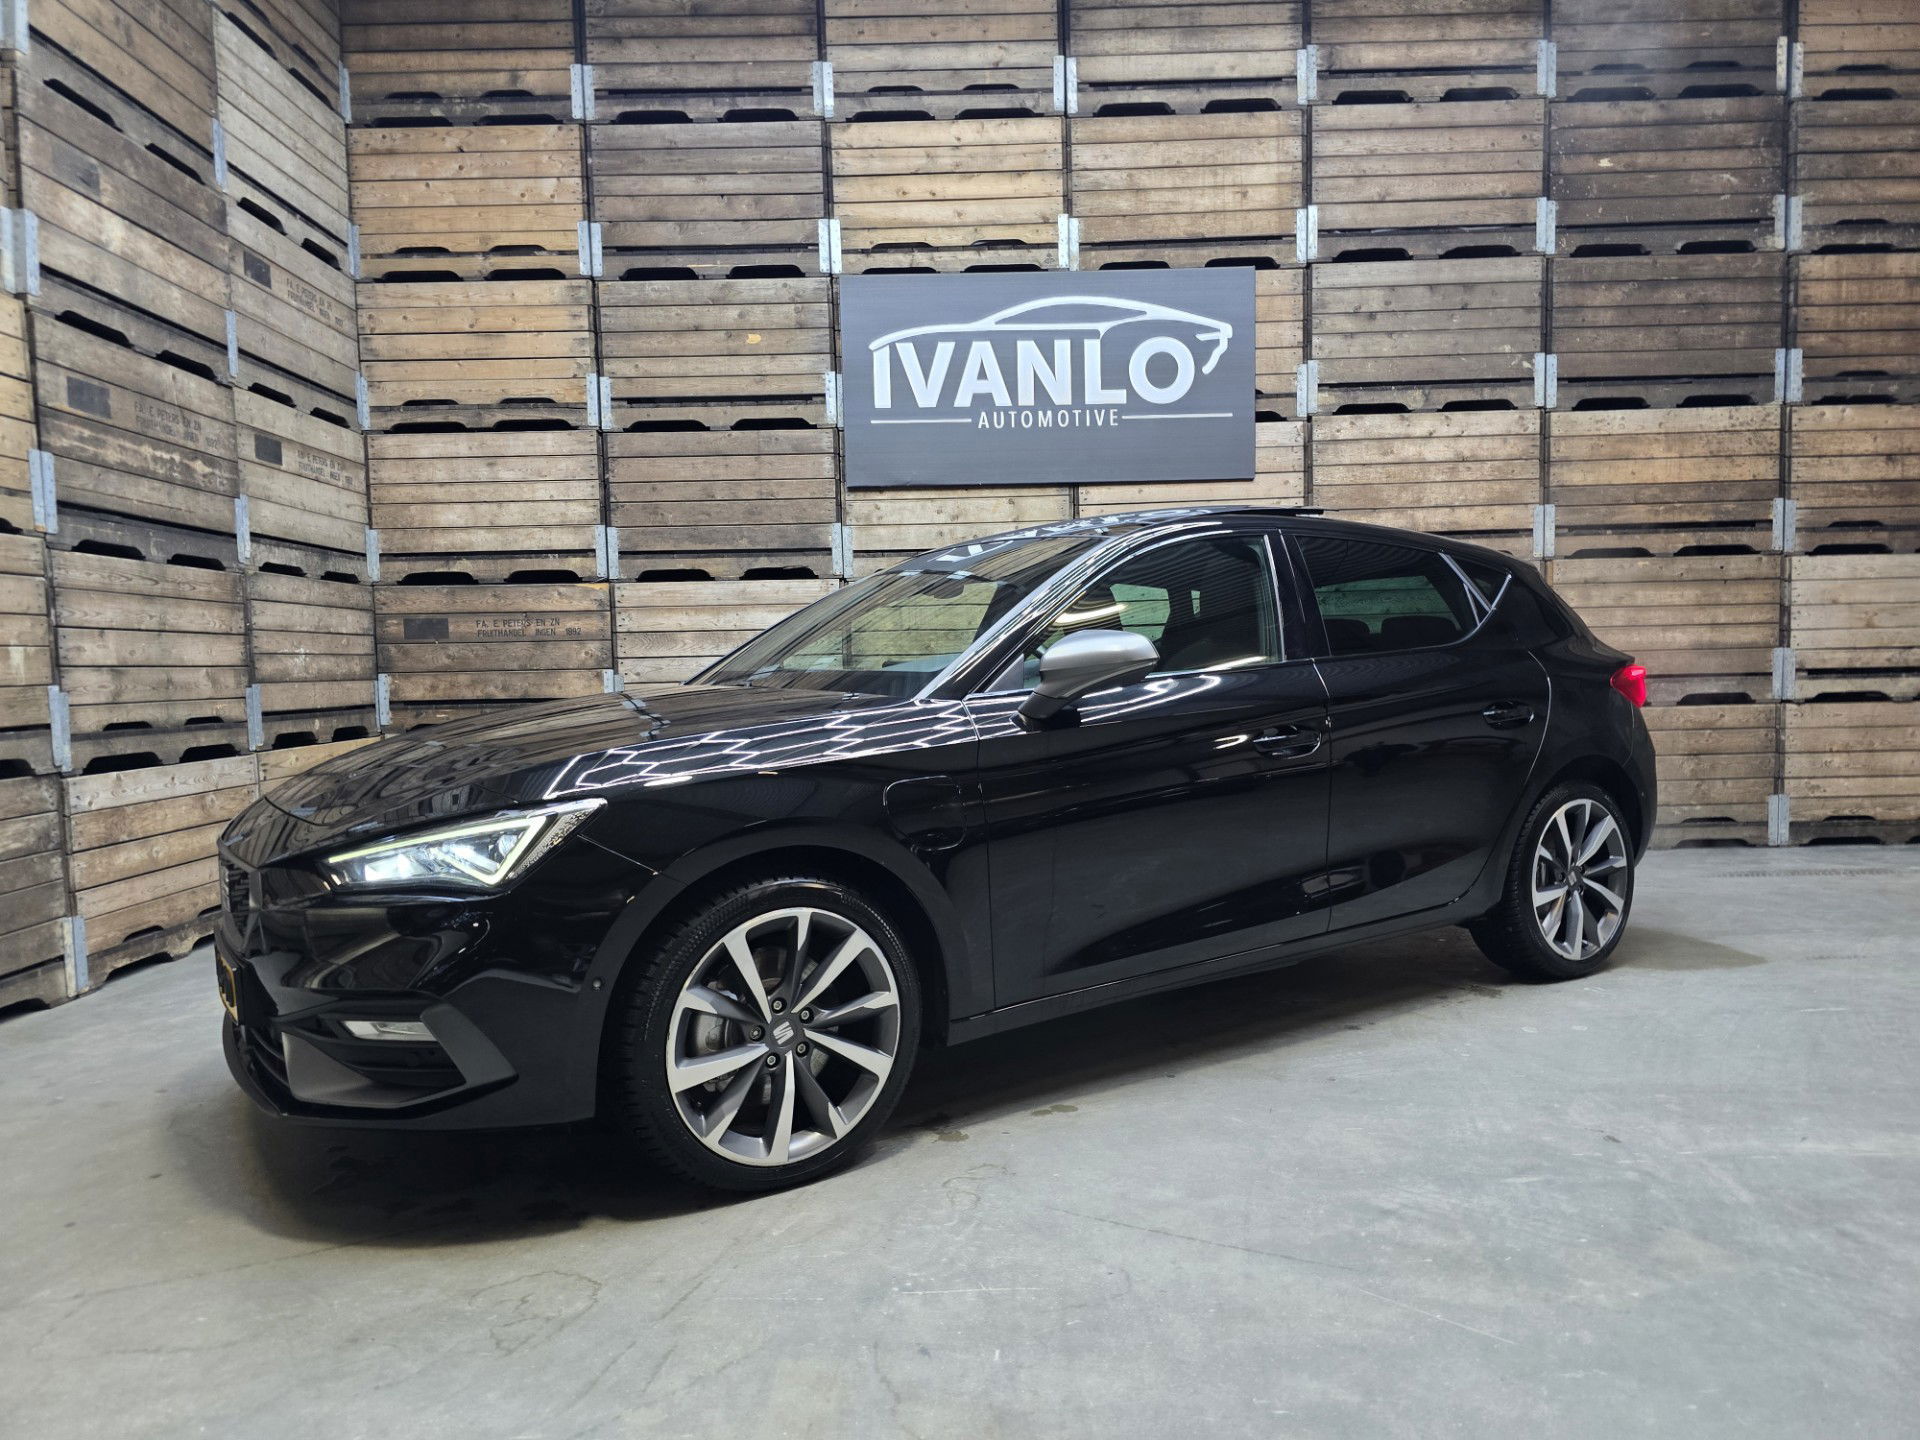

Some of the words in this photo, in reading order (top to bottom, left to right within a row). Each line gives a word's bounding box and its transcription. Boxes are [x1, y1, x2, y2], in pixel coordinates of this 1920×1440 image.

[872, 335, 1196, 408] IVANLO
[977, 408, 1120, 429] AUTOMOTIVE
[502, 618, 532, 628] PETERS
[536, 618, 546, 627] EN
[550, 617, 560, 627] ZN
